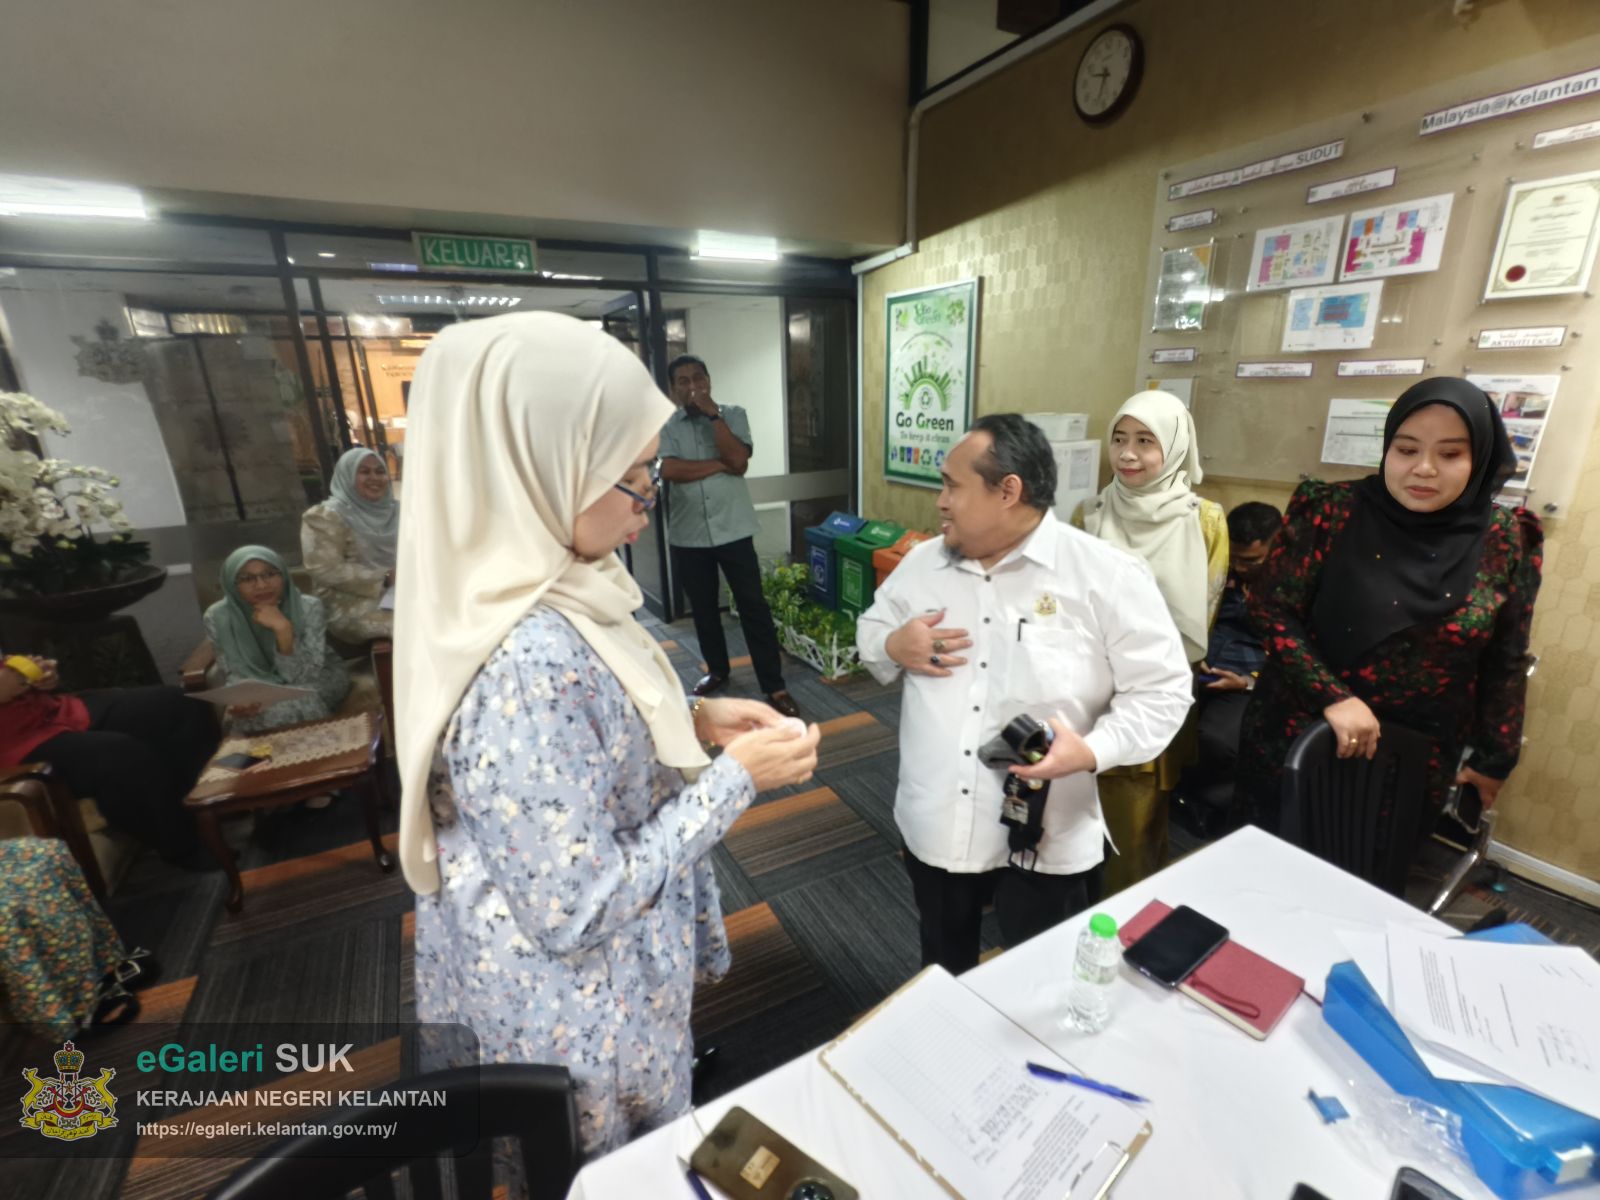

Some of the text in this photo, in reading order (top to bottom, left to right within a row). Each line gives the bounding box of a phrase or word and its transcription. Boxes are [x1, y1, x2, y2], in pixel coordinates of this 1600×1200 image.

[1422, 76, 1598, 130] Malaysia@Kelantan
[1296, 143, 1341, 166] SUDUT
[423, 238, 510, 267] KELUAR
[896, 411, 954, 431] Go Green
